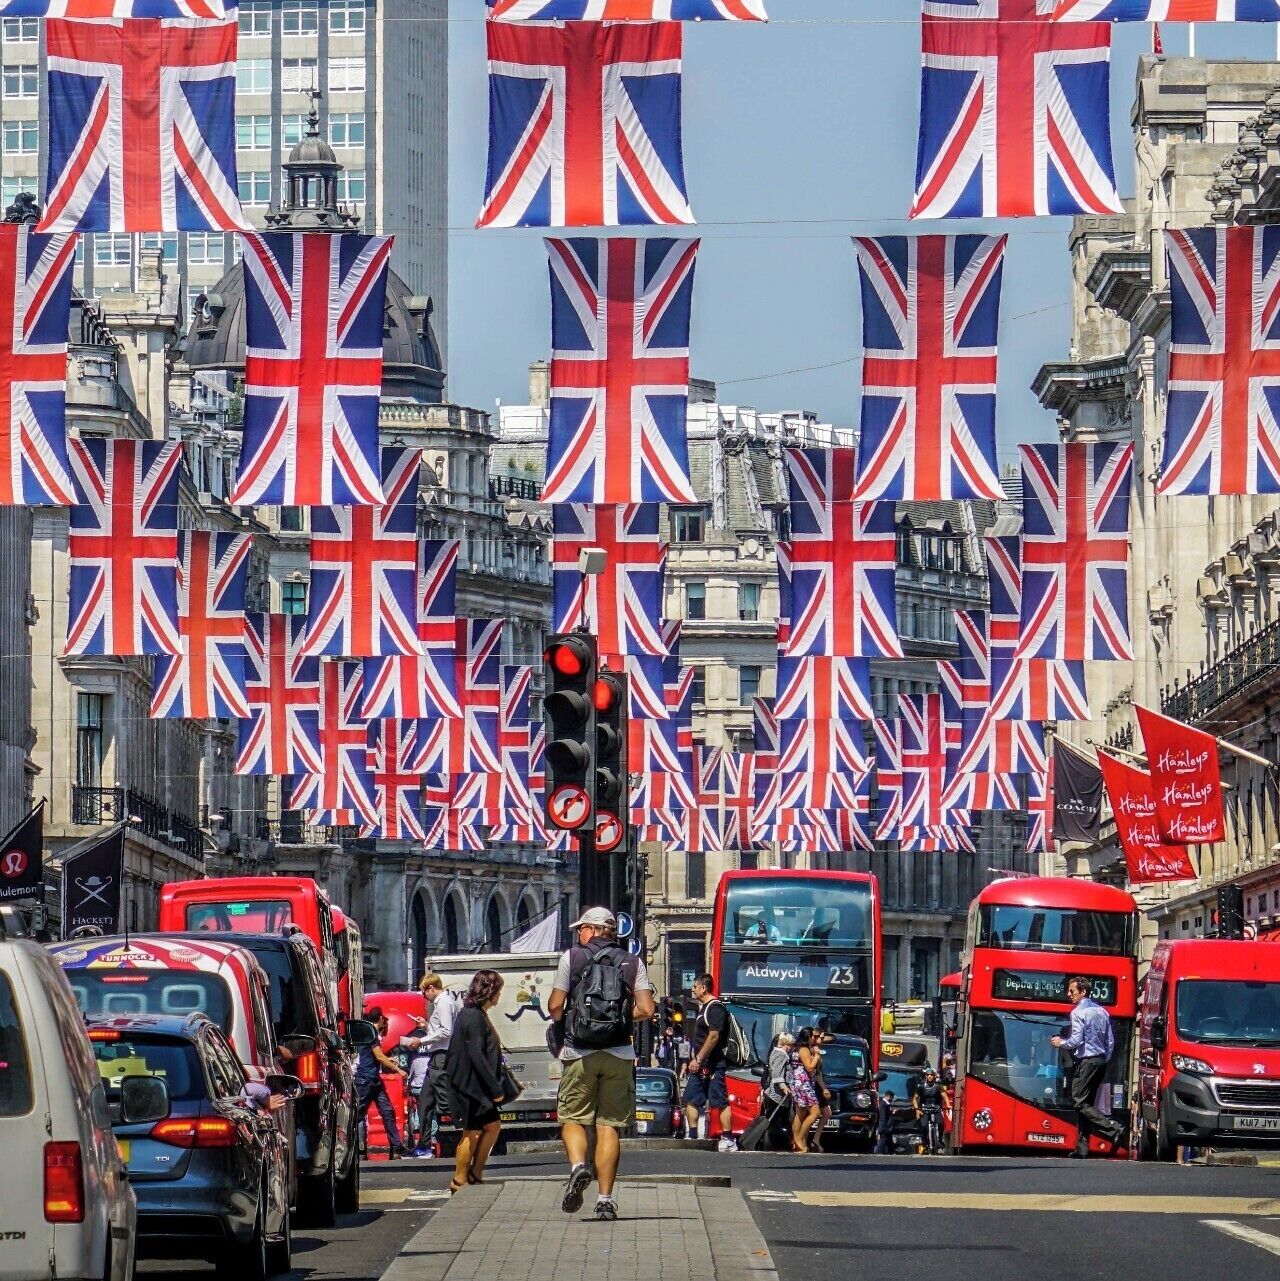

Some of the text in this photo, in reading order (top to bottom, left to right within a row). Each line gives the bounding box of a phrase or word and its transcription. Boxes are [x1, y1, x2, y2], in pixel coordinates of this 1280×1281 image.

[1157, 748, 1209, 773] Hamleys
[1161, 780, 1212, 807] Hamleys
[1118, 792, 1157, 815] Hamle
[1168, 813, 1218, 839] Hamleys
[72, 917, 114, 925] HACKETT
[745, 967, 803, 982] Aldwych
[829, 966, 854, 985] 23
[1089, 980, 1109, 999] 53
[883, 1044, 902, 1054] ups
[1240, 1118, 1278, 1129] KU17 JYV
